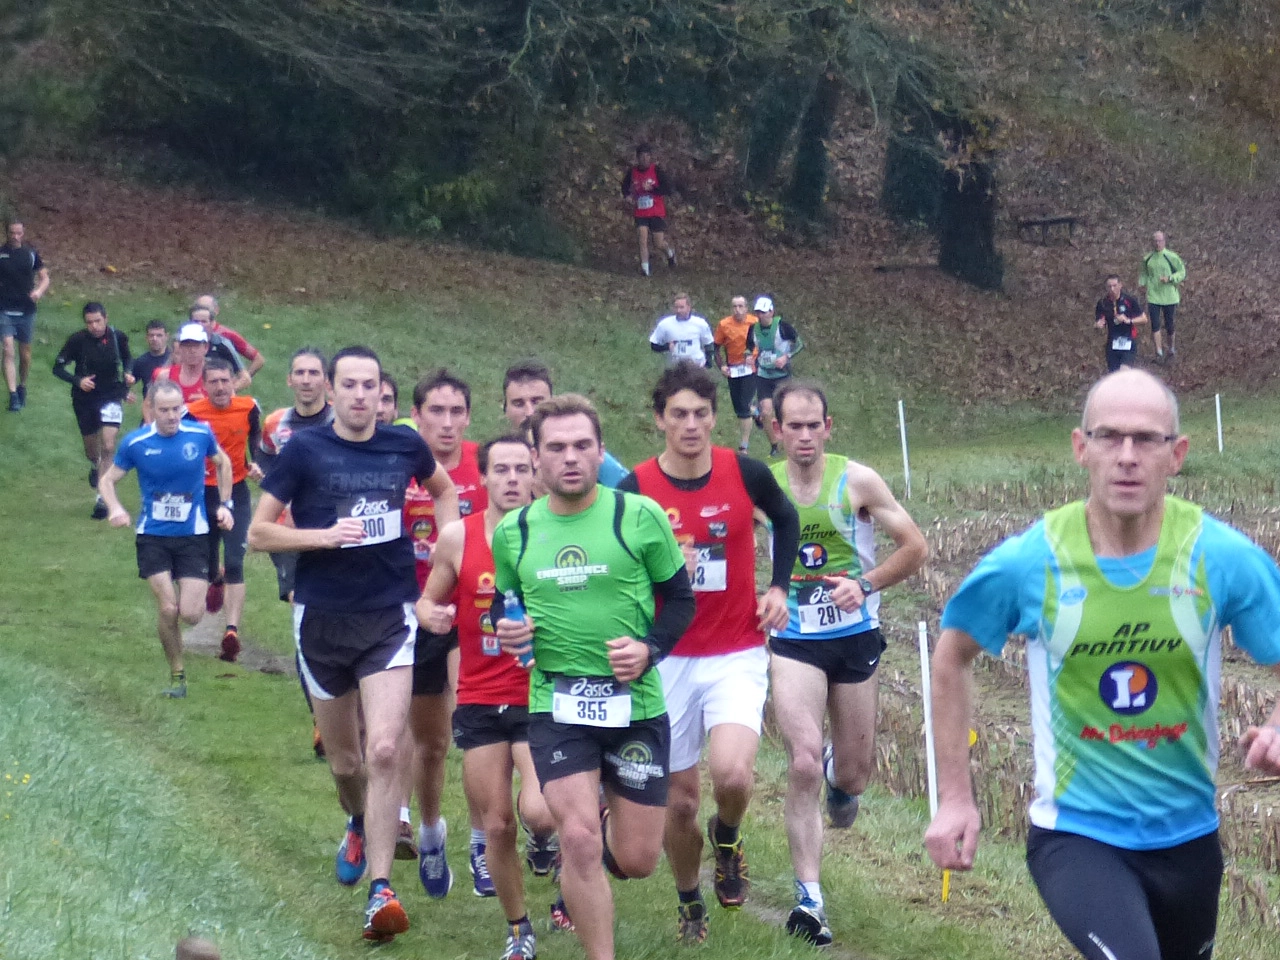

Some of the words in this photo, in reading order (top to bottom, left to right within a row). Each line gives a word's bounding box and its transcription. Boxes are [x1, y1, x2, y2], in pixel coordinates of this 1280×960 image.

[803, 523, 820, 532] AP
[536, 565, 608, 579] ENDURANCE
[557, 575, 587, 585] SHOP
[1113, 622, 1151, 639] AP
[1070, 638, 1183, 658] PONTIVY
[573, 677, 613, 697] asics
[577, 700, 608, 721] 355
[617, 766, 649, 783] SHOP
